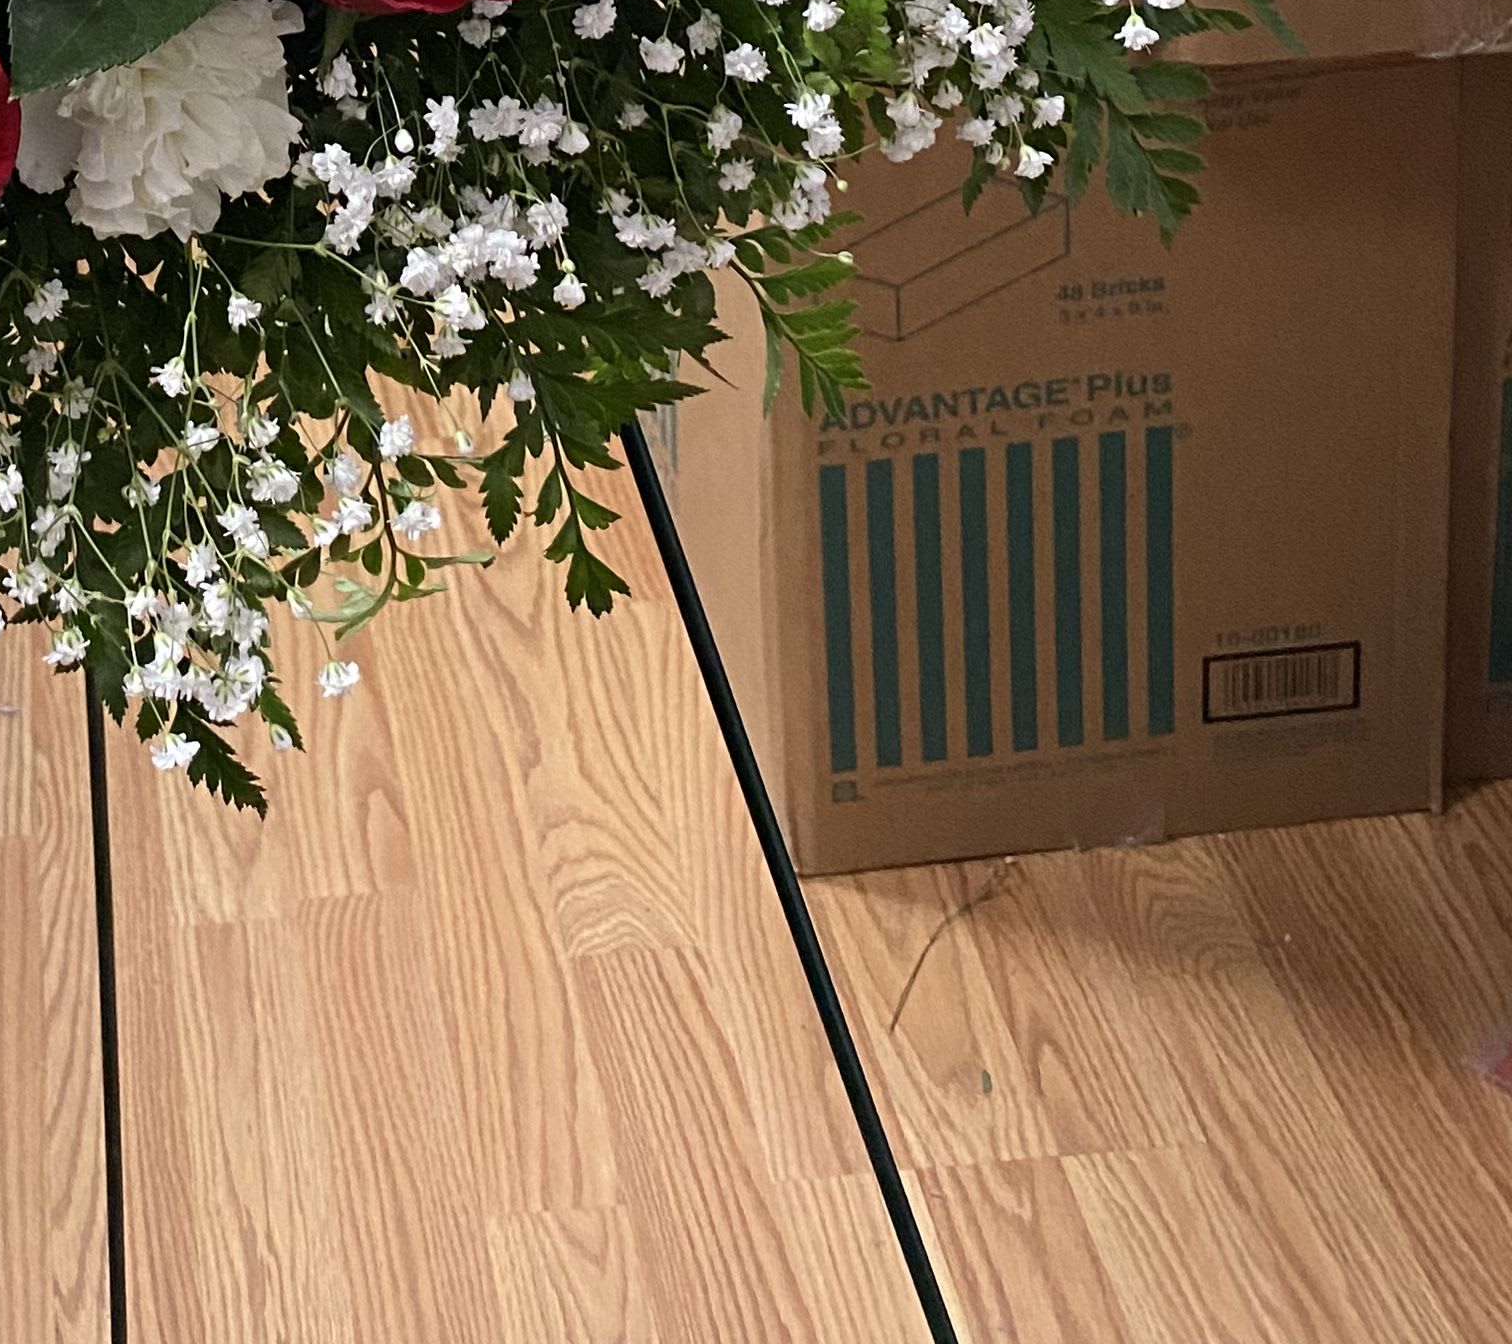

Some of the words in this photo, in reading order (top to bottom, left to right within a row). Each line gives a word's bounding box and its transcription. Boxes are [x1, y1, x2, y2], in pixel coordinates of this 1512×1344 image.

[1057, 282, 1084, 302] 48
[1091, 276, 1165, 300] Bricks
[818, 419, 1008, 456] FLORAL
[1038, 399, 1174, 430] FOAM
[819, 377, 1071, 432] ADVANTAGE
[1087, 371, 1173, 401] Plus
